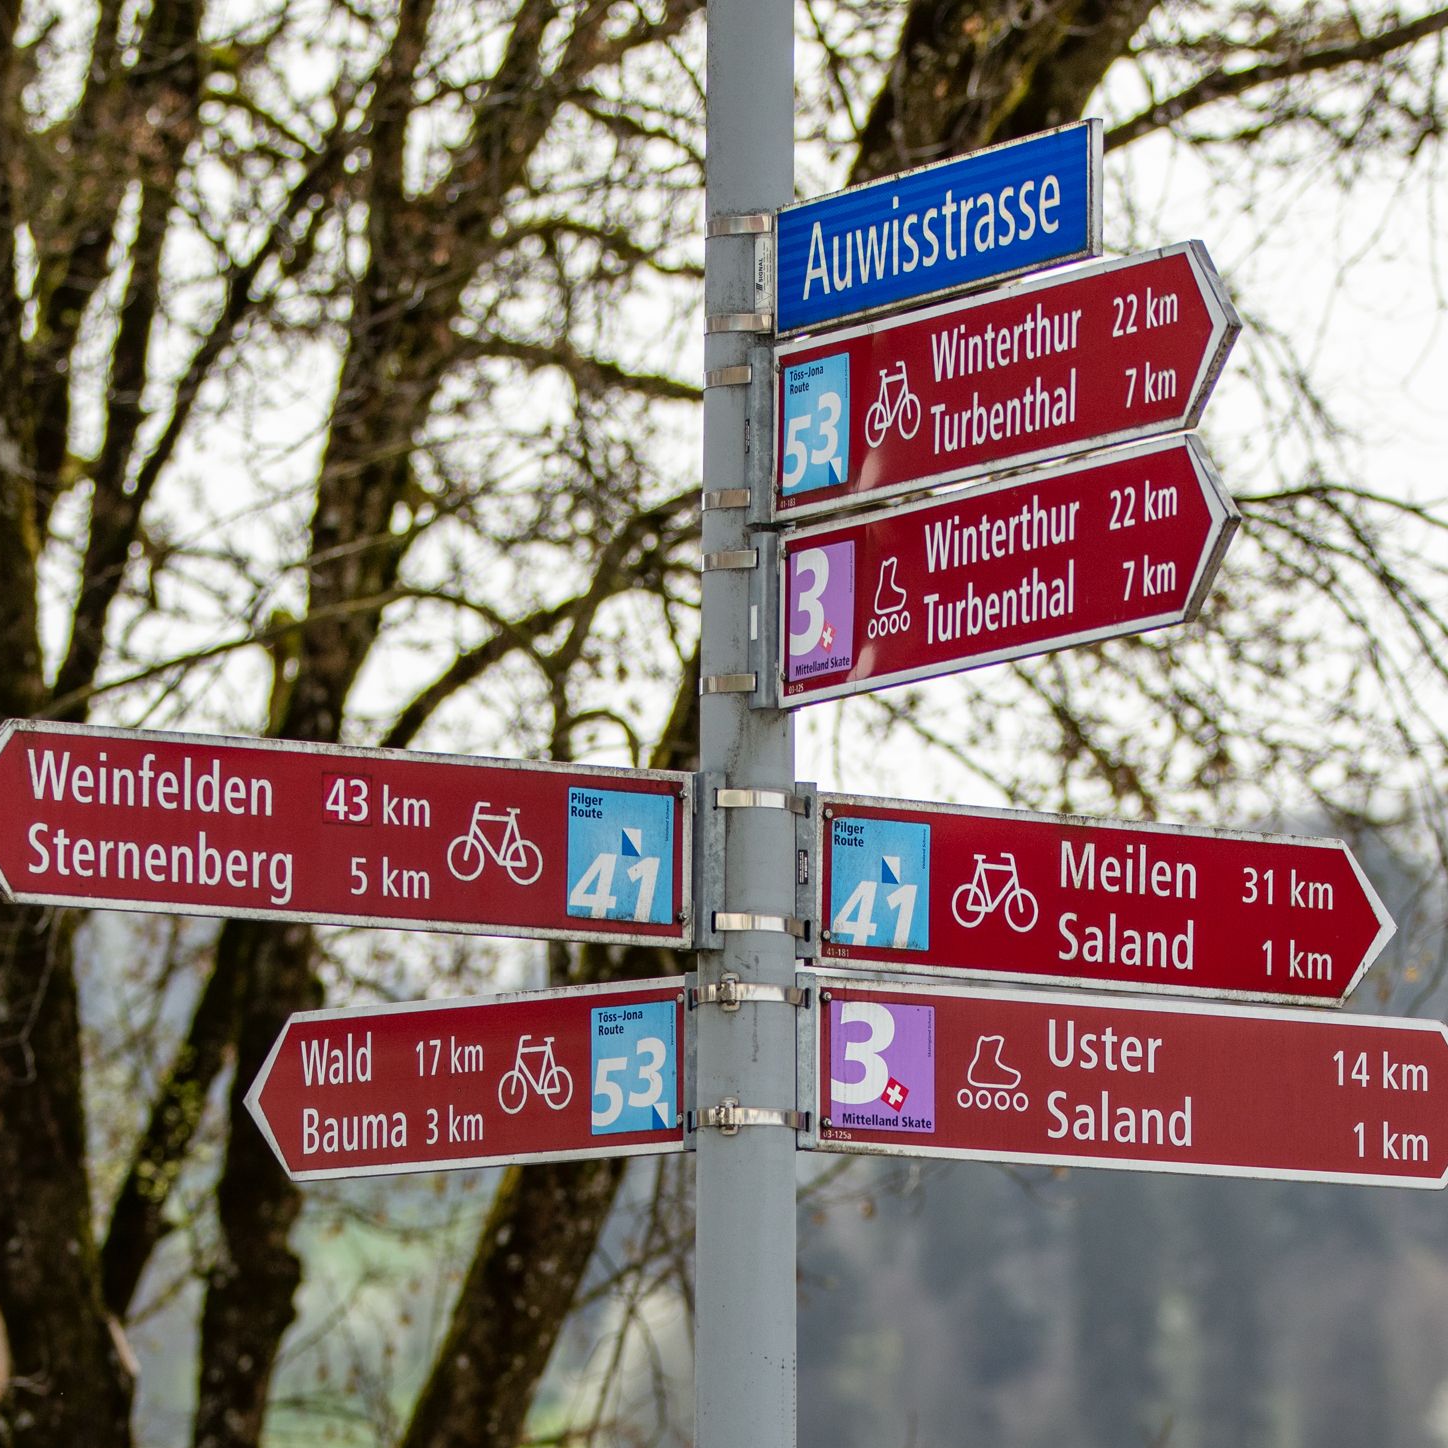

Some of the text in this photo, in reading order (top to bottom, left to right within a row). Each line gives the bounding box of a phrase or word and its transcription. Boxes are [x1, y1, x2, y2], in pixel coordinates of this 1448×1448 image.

[803, 175, 1060, 300] Auwisstrasse
[931, 290, 1178, 382] Winterthur 22 km
[790, 380, 809, 395] Route
[930, 364, 1176, 454] Turbenthal 7 km
[783, 392, 841, 488] 53
[924, 483, 1178, 573] Winterthur 22 km
[790, 548, 829, 656] 3
[923, 558, 1176, 644] Turbenthal 7 km
[796, 656, 851, 678] Mittelland Skate
[27, 748, 431, 828] Weinfelden 43 km
[571, 793, 603, 808] Pilger
[571, 804, 602, 819] Route
[28, 822, 430, 905] Sternenberg 5 km
[833, 820, 864, 838] Pilger
[834, 834, 864, 847] Route
[569, 853, 660, 922] 41
[1061, 840, 1333, 910] Meilen 31 km
[832, 881, 917, 948] 41
[1058, 912, 1333, 981] Saland 1 km
[827, 948, 850, 957] 41-181
[301, 1032, 484, 1086] Wald 17 km
[599, 1025, 624, 1036] Route
[831, 1002, 895, 1104] 3
[1048, 1019, 1429, 1092] Uster 14 km
[592, 1037, 666, 1126] 53
[303, 1105, 484, 1156] Bauma 3 km
[823, 1130, 851, 1139] 03-125a
[842, 1113, 931, 1129] Mittelland Skate
[1046, 1090, 1429, 1162] Saland 1 km
